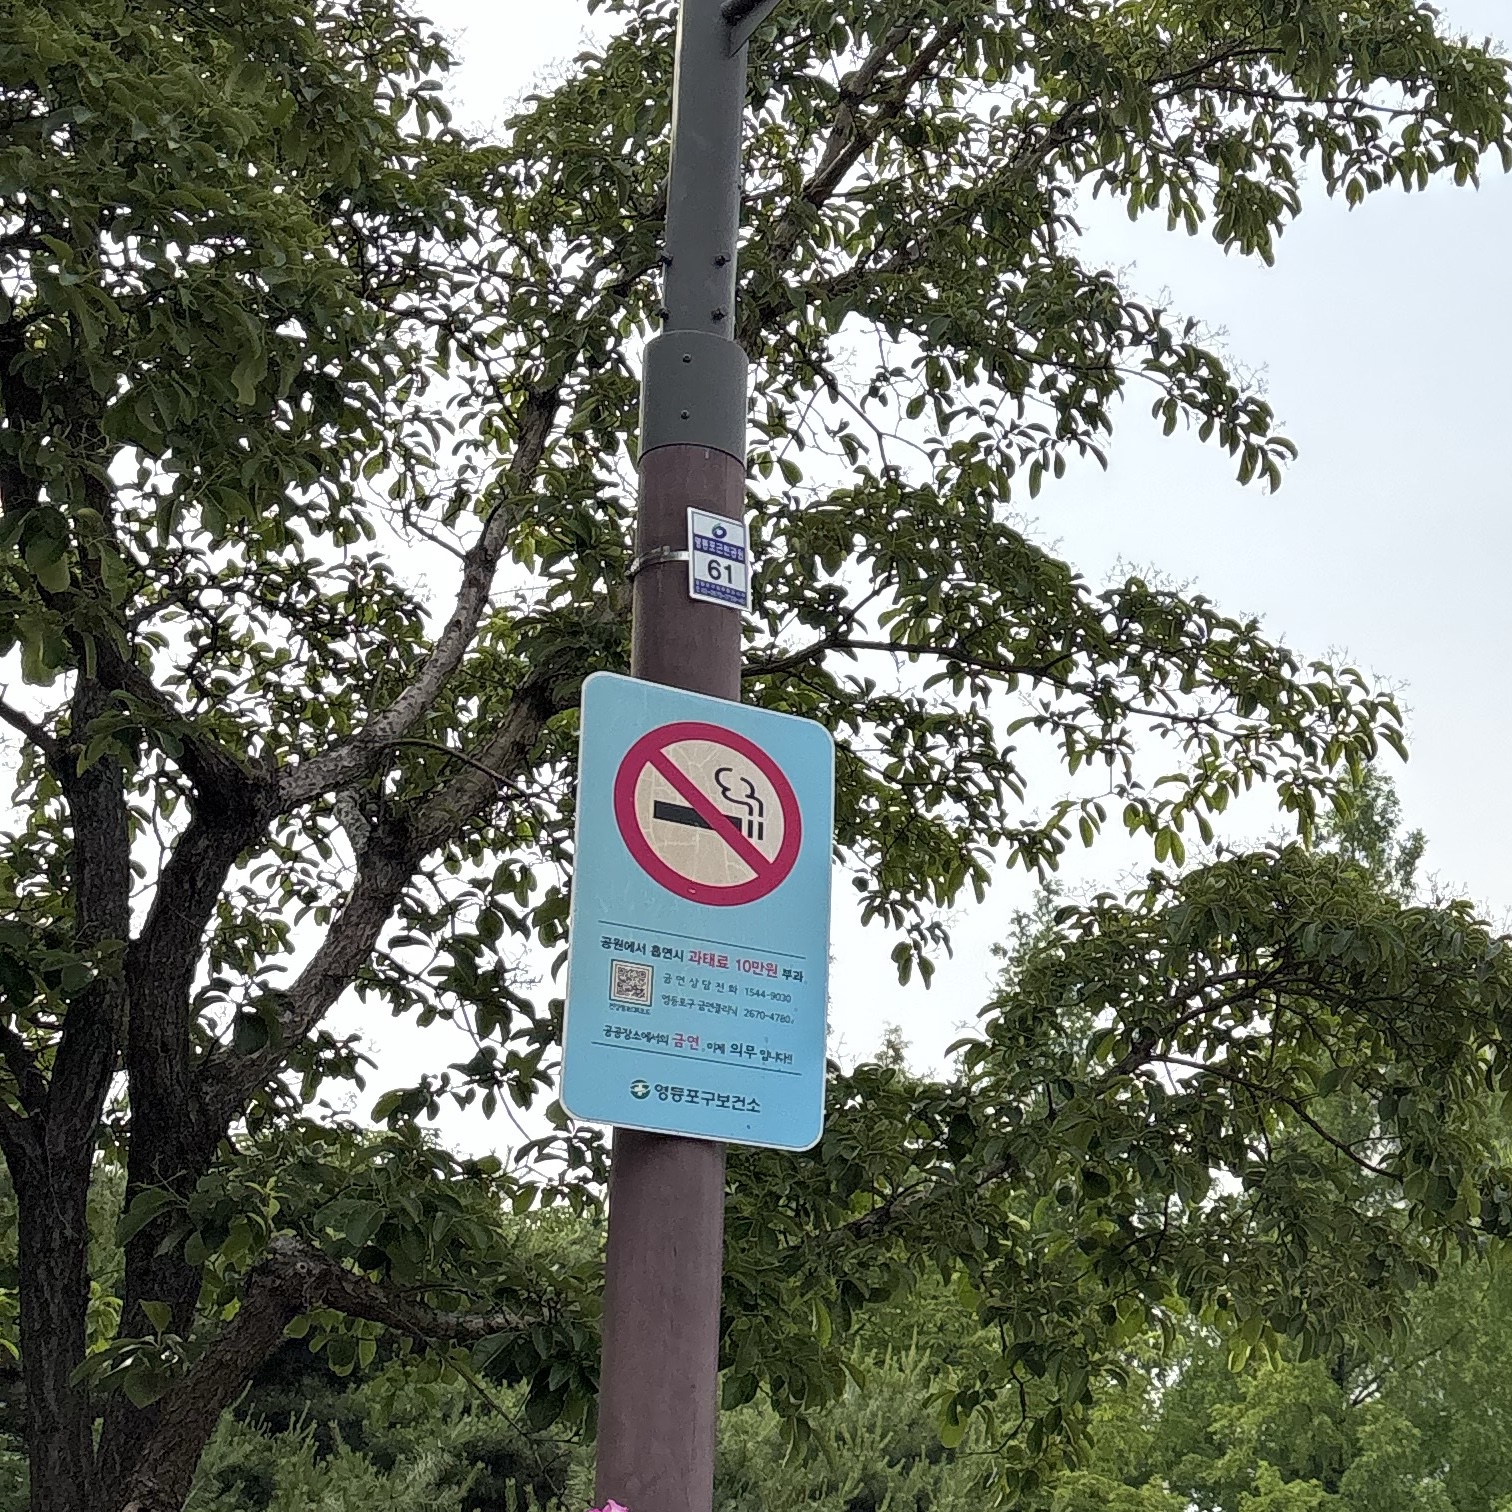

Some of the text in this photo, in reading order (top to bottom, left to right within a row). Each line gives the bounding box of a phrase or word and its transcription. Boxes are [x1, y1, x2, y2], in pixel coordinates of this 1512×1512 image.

[707, 559, 733, 584] 61
[600, 935, 804, 983] 공원에서 흡연시 과태료 10만원 부과
[603, 1025, 669, 1046] 공공장소에서의
[672, 1033, 700, 1051] 금연
[730, 1042, 758, 1060] 의무
[654, 1083, 761, 1114] 영등포구보건소
